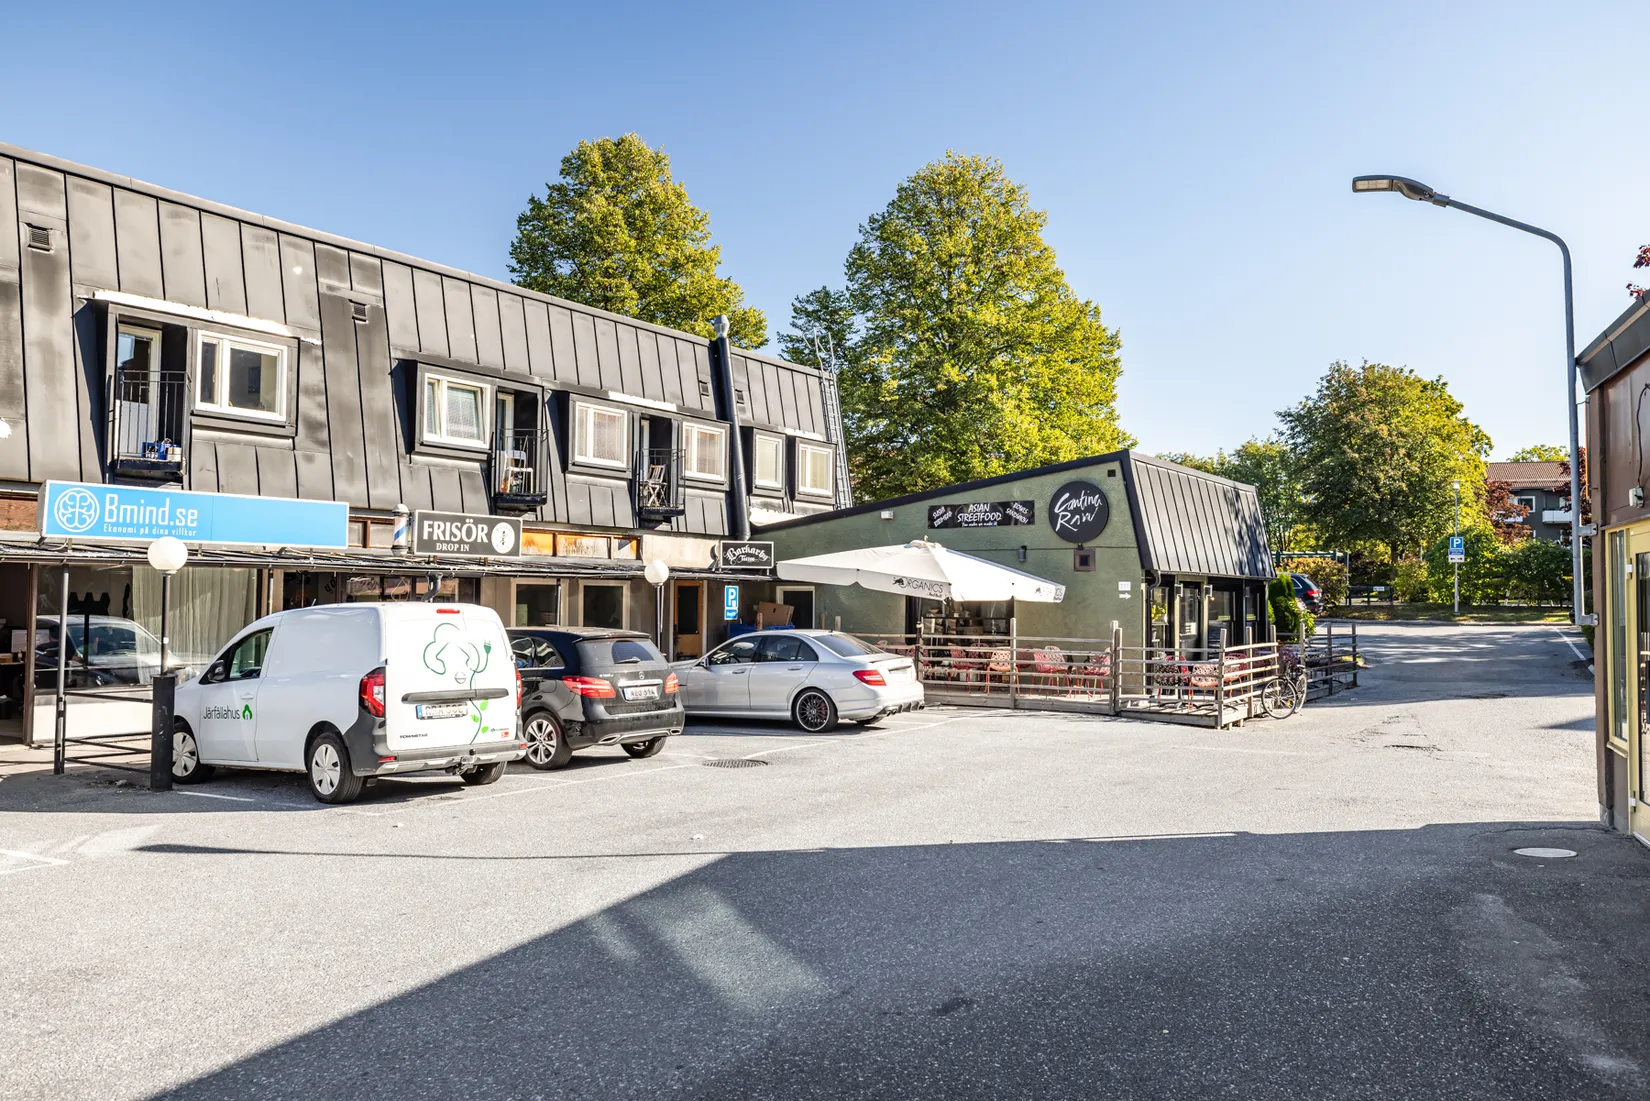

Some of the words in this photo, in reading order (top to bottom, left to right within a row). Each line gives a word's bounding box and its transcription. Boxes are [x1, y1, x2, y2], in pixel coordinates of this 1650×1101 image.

[968, 503, 990, 513] ASIAN
[1054, 490, 1102, 513] Cantina
[104, 494, 198, 527] Bmind.se
[957, 512, 1002, 523] STREETFOOD
[103, 525, 137, 533] Ekonomi
[140, 526, 149, 535] på
[152, 526, 168, 535] dina
[171, 528, 197, 536] villkor
[422, 518, 489, 543] FRISÖR
[436, 543, 459, 551] DROP
[460, 544, 470, 552] IN
[1454, 539, 1461, 548] P
[723, 544, 770, 561] Barkarby
[728, 588, 737, 606] P
[203, 705, 240, 720] Järfällahus
